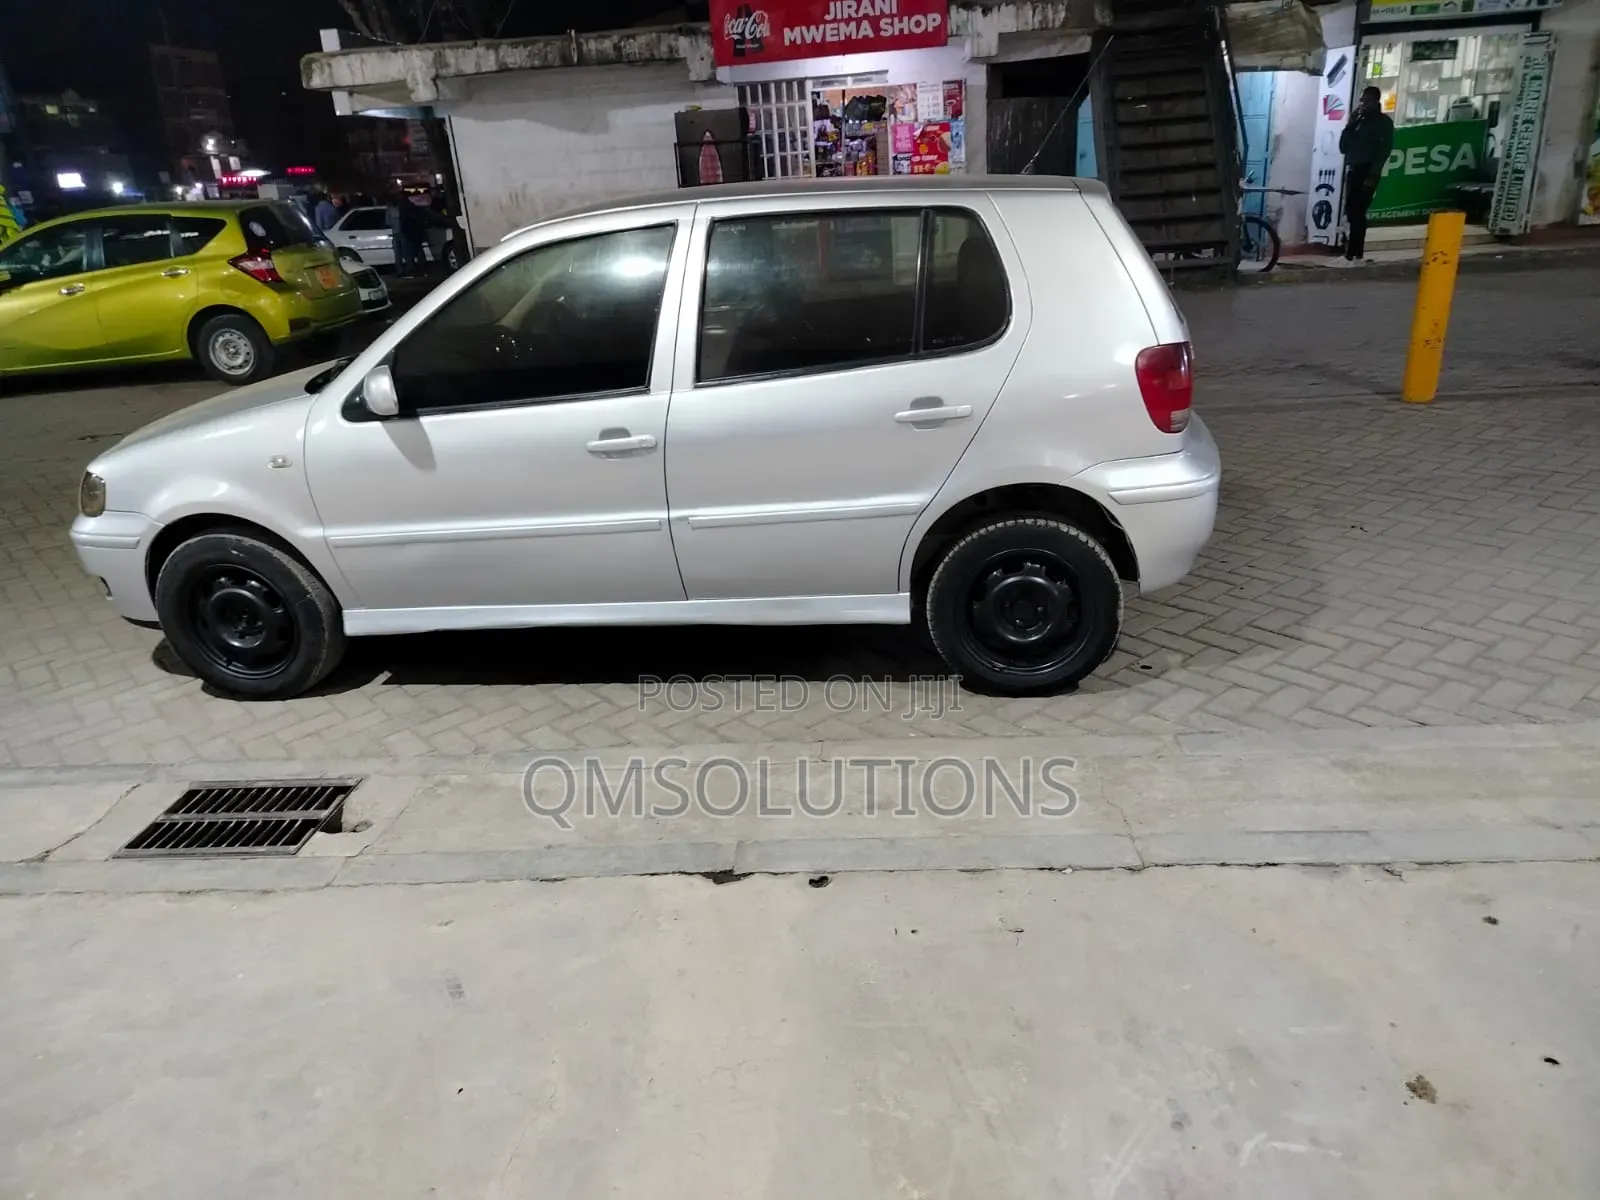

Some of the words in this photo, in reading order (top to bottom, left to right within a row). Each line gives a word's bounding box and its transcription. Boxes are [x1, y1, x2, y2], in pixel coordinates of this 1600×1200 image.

[824, 0, 897, 20] JIRANI
[783, 19, 874, 46] MWEMA
[880, 13, 942, 37] SHOP
[1381, 142, 1477, 177] PESA
[1512, 123, 1535, 170] CENTRE
[1501, 173, 1525, 221] LIMITED
